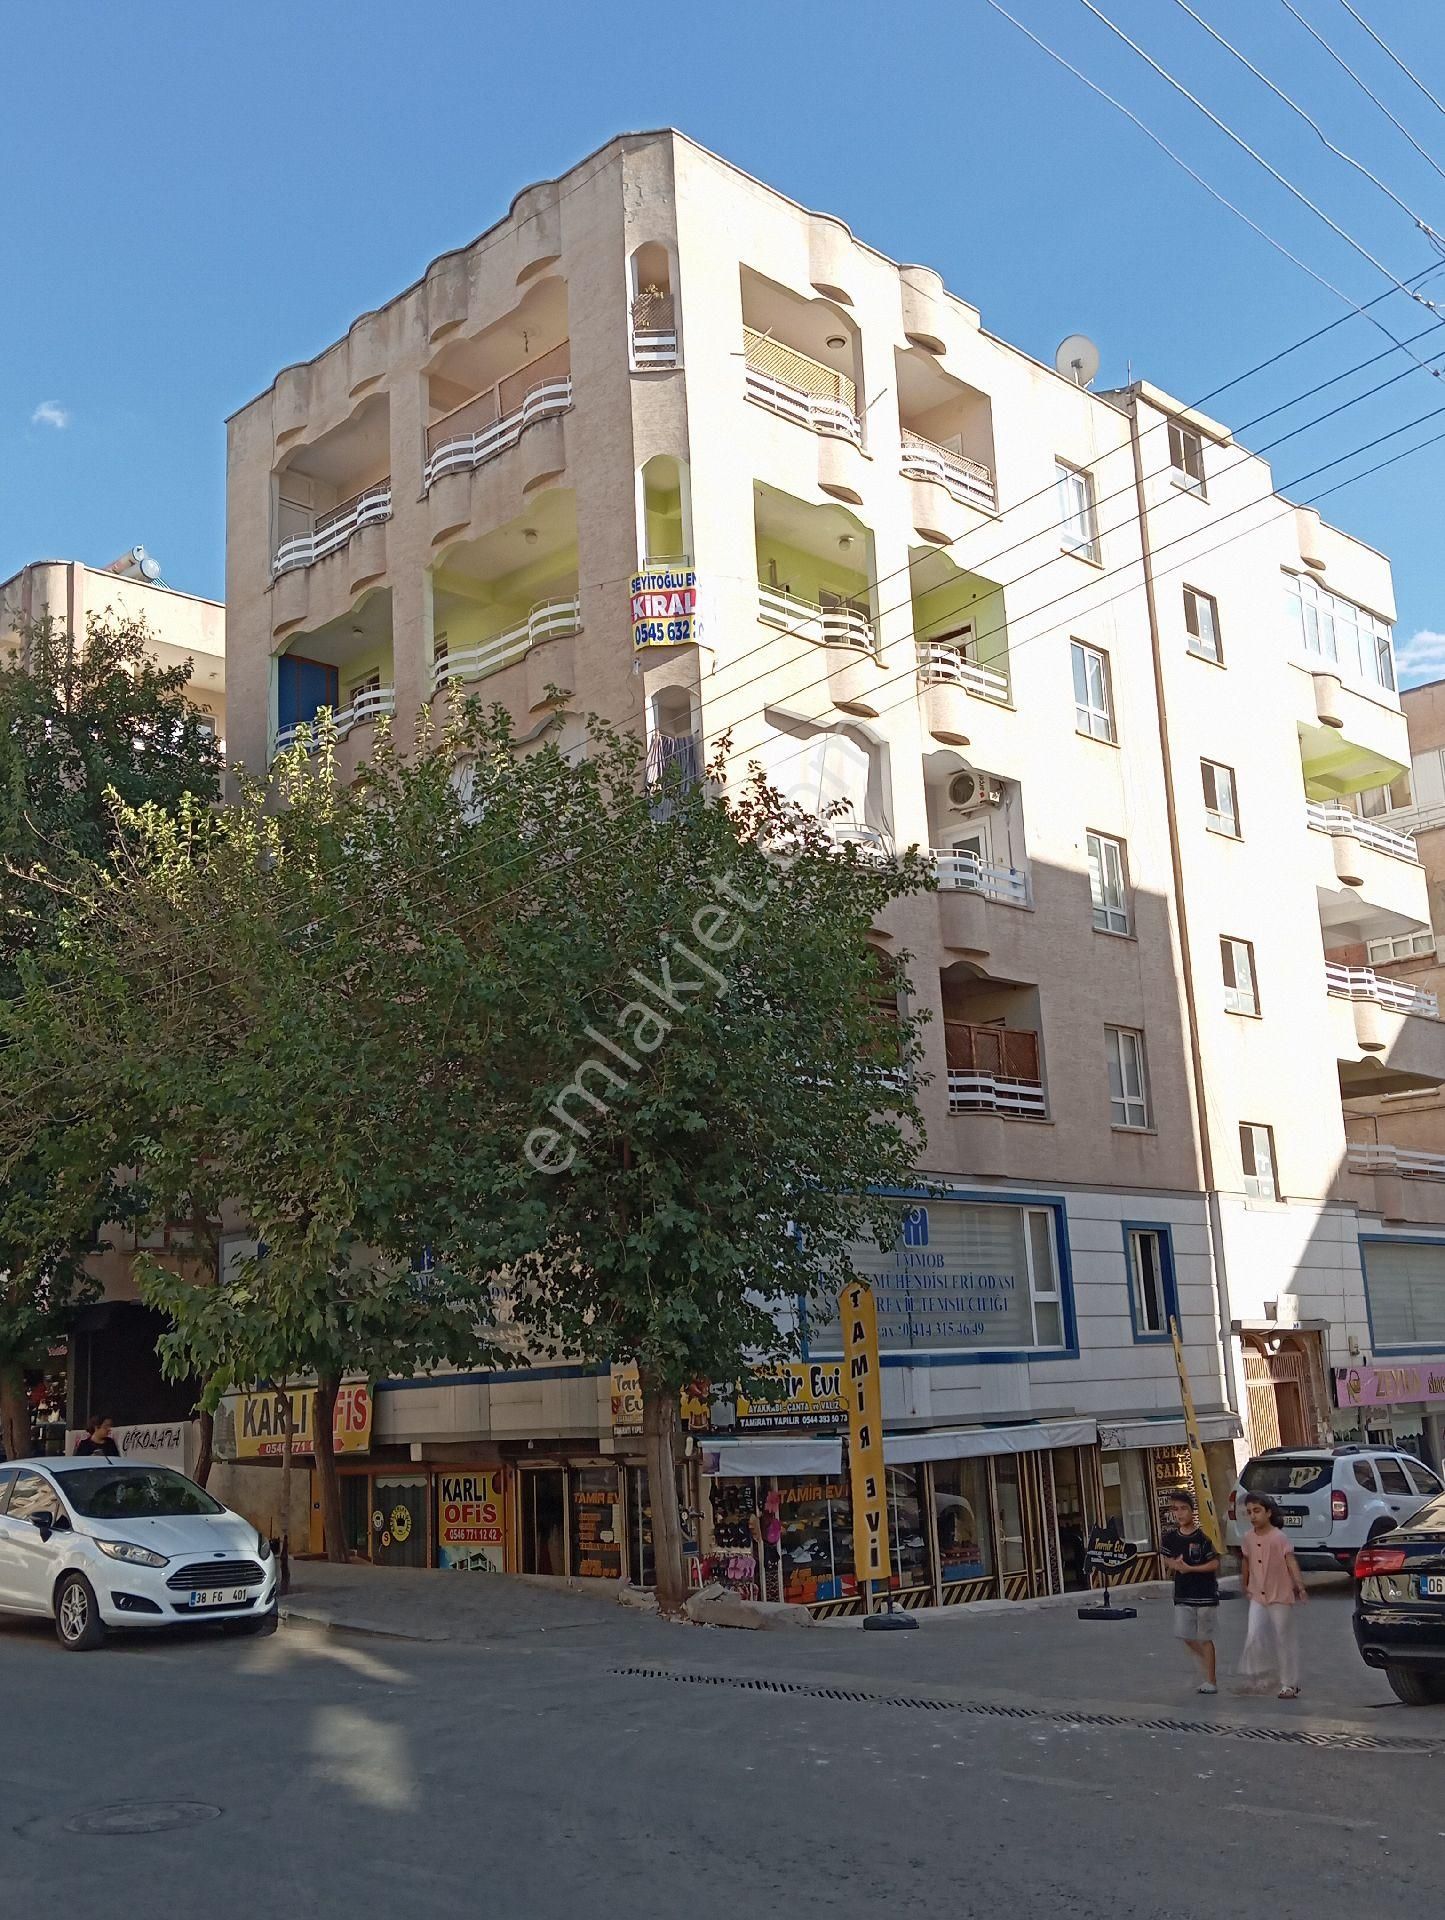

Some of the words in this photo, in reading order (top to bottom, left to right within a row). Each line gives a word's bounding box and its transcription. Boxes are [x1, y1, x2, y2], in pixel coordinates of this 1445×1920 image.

[631, 571, 684, 593] SEYİTOĞLU
[635, 622, 664, 645] 0545
[667, 620, 690, 641] 632
[896, 1253, 945, 1268] TMMOB
[811, 1366, 840, 1398] Evi
[243, 1393, 307, 1438] KARLI
[442, 1478, 487, 1502] KARLI
[449, 1528, 465, 1541] 0546
[466, 1528, 478, 1541] 771
[480, 1528, 488, 1541] 12
[489, 1528, 498, 1541] 42
[196, 1592, 207, 1603] 38
[212, 1591, 223, 1602] FG
[232, 1589, 247, 1601] 401
[1429, 1578, 1443, 1593] 06
